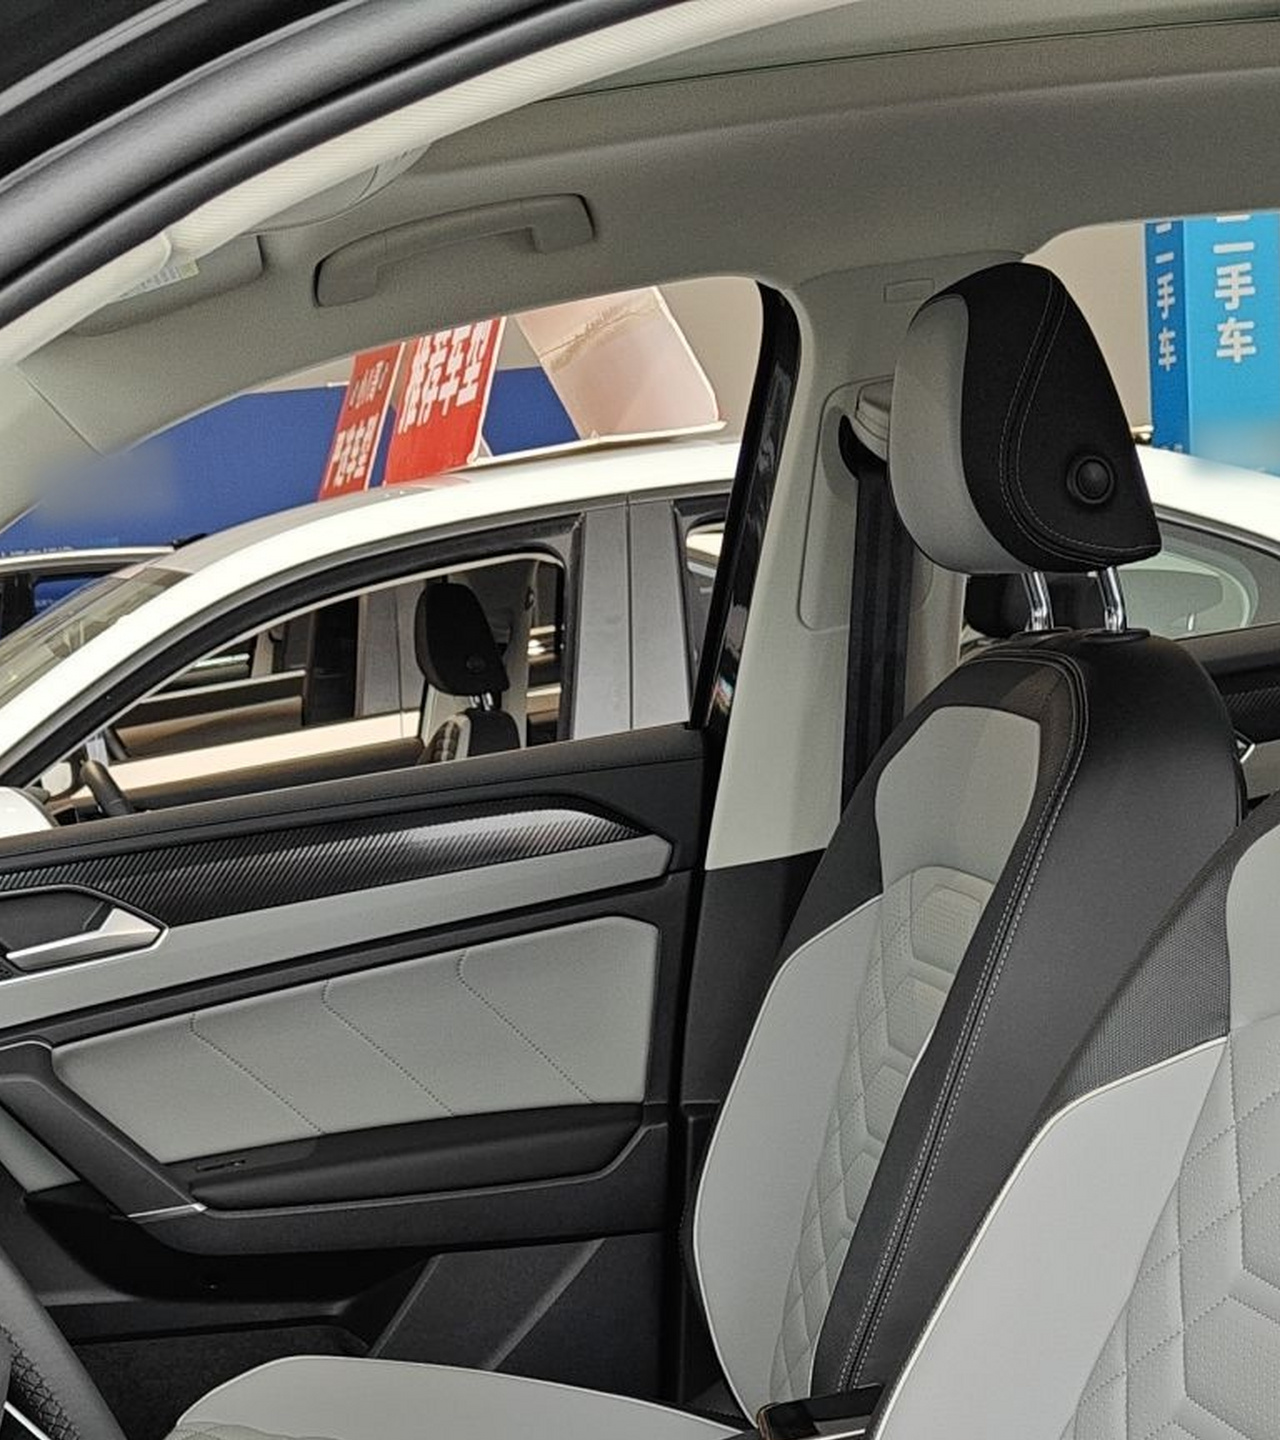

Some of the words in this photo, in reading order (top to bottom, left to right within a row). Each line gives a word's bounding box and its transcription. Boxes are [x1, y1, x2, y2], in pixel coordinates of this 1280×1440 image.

[1155, 222, 1176, 371] 二手车
[1213, 214, 1256, 363] 二手车
